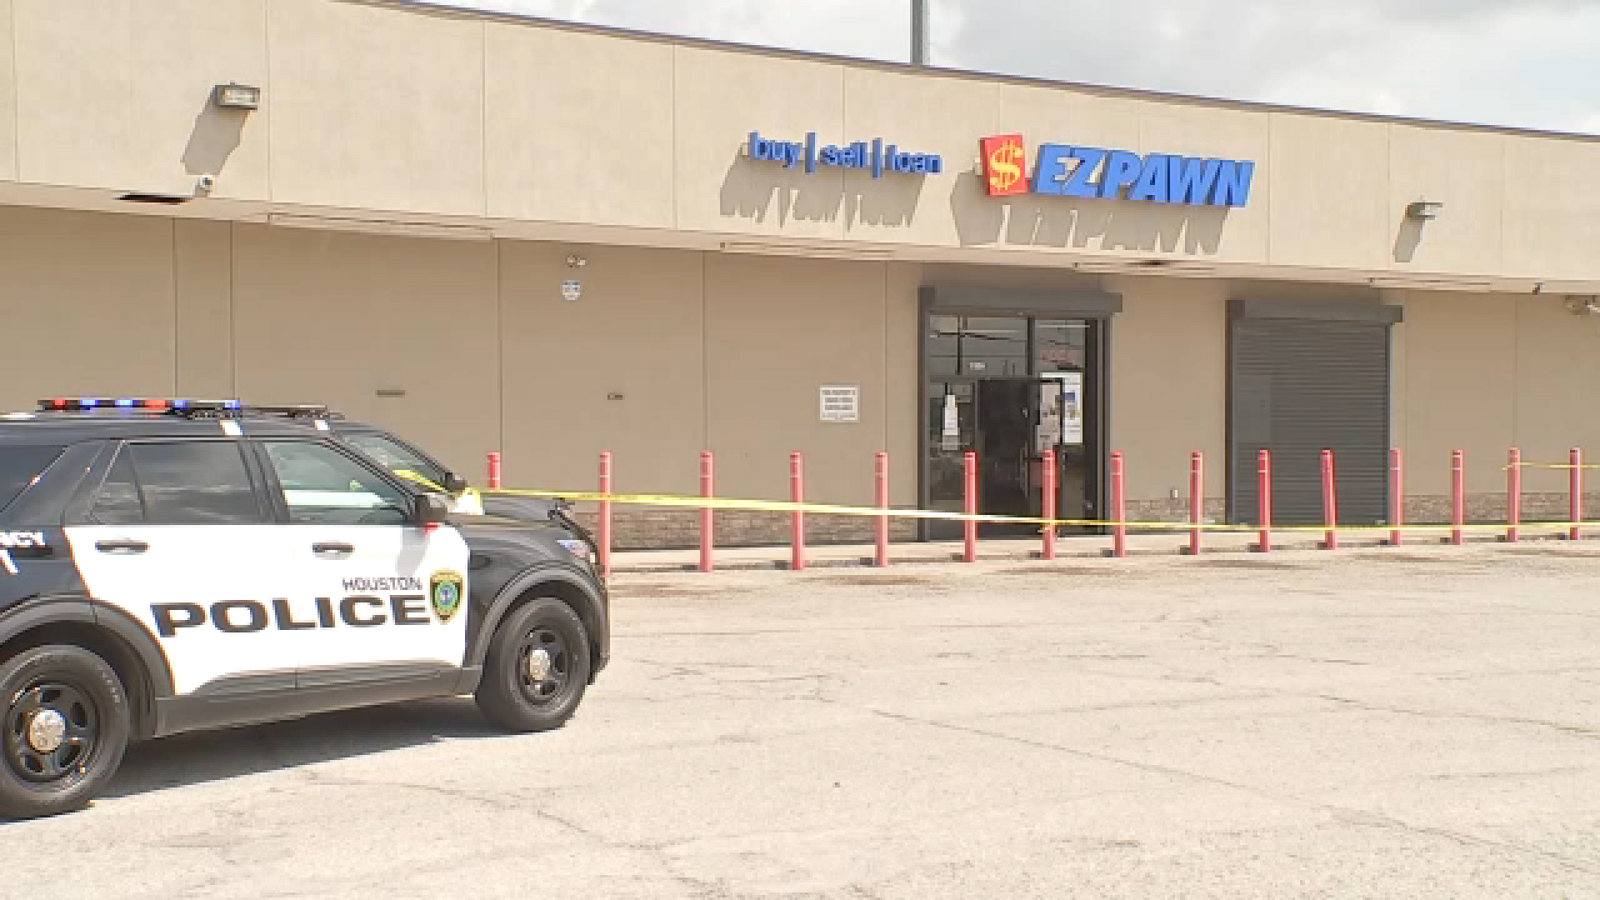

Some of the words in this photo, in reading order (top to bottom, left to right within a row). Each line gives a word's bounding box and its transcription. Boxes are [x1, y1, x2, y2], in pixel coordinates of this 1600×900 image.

[749, 132, 800, 170] buy
[820, 140, 868, 167] sell
[884, 144, 942, 175] loan
[1035, 143, 1255, 207] EZPAWN
[341, 577, 422, 592] HOUSTON
[150, 595, 430, 637] POLICE
